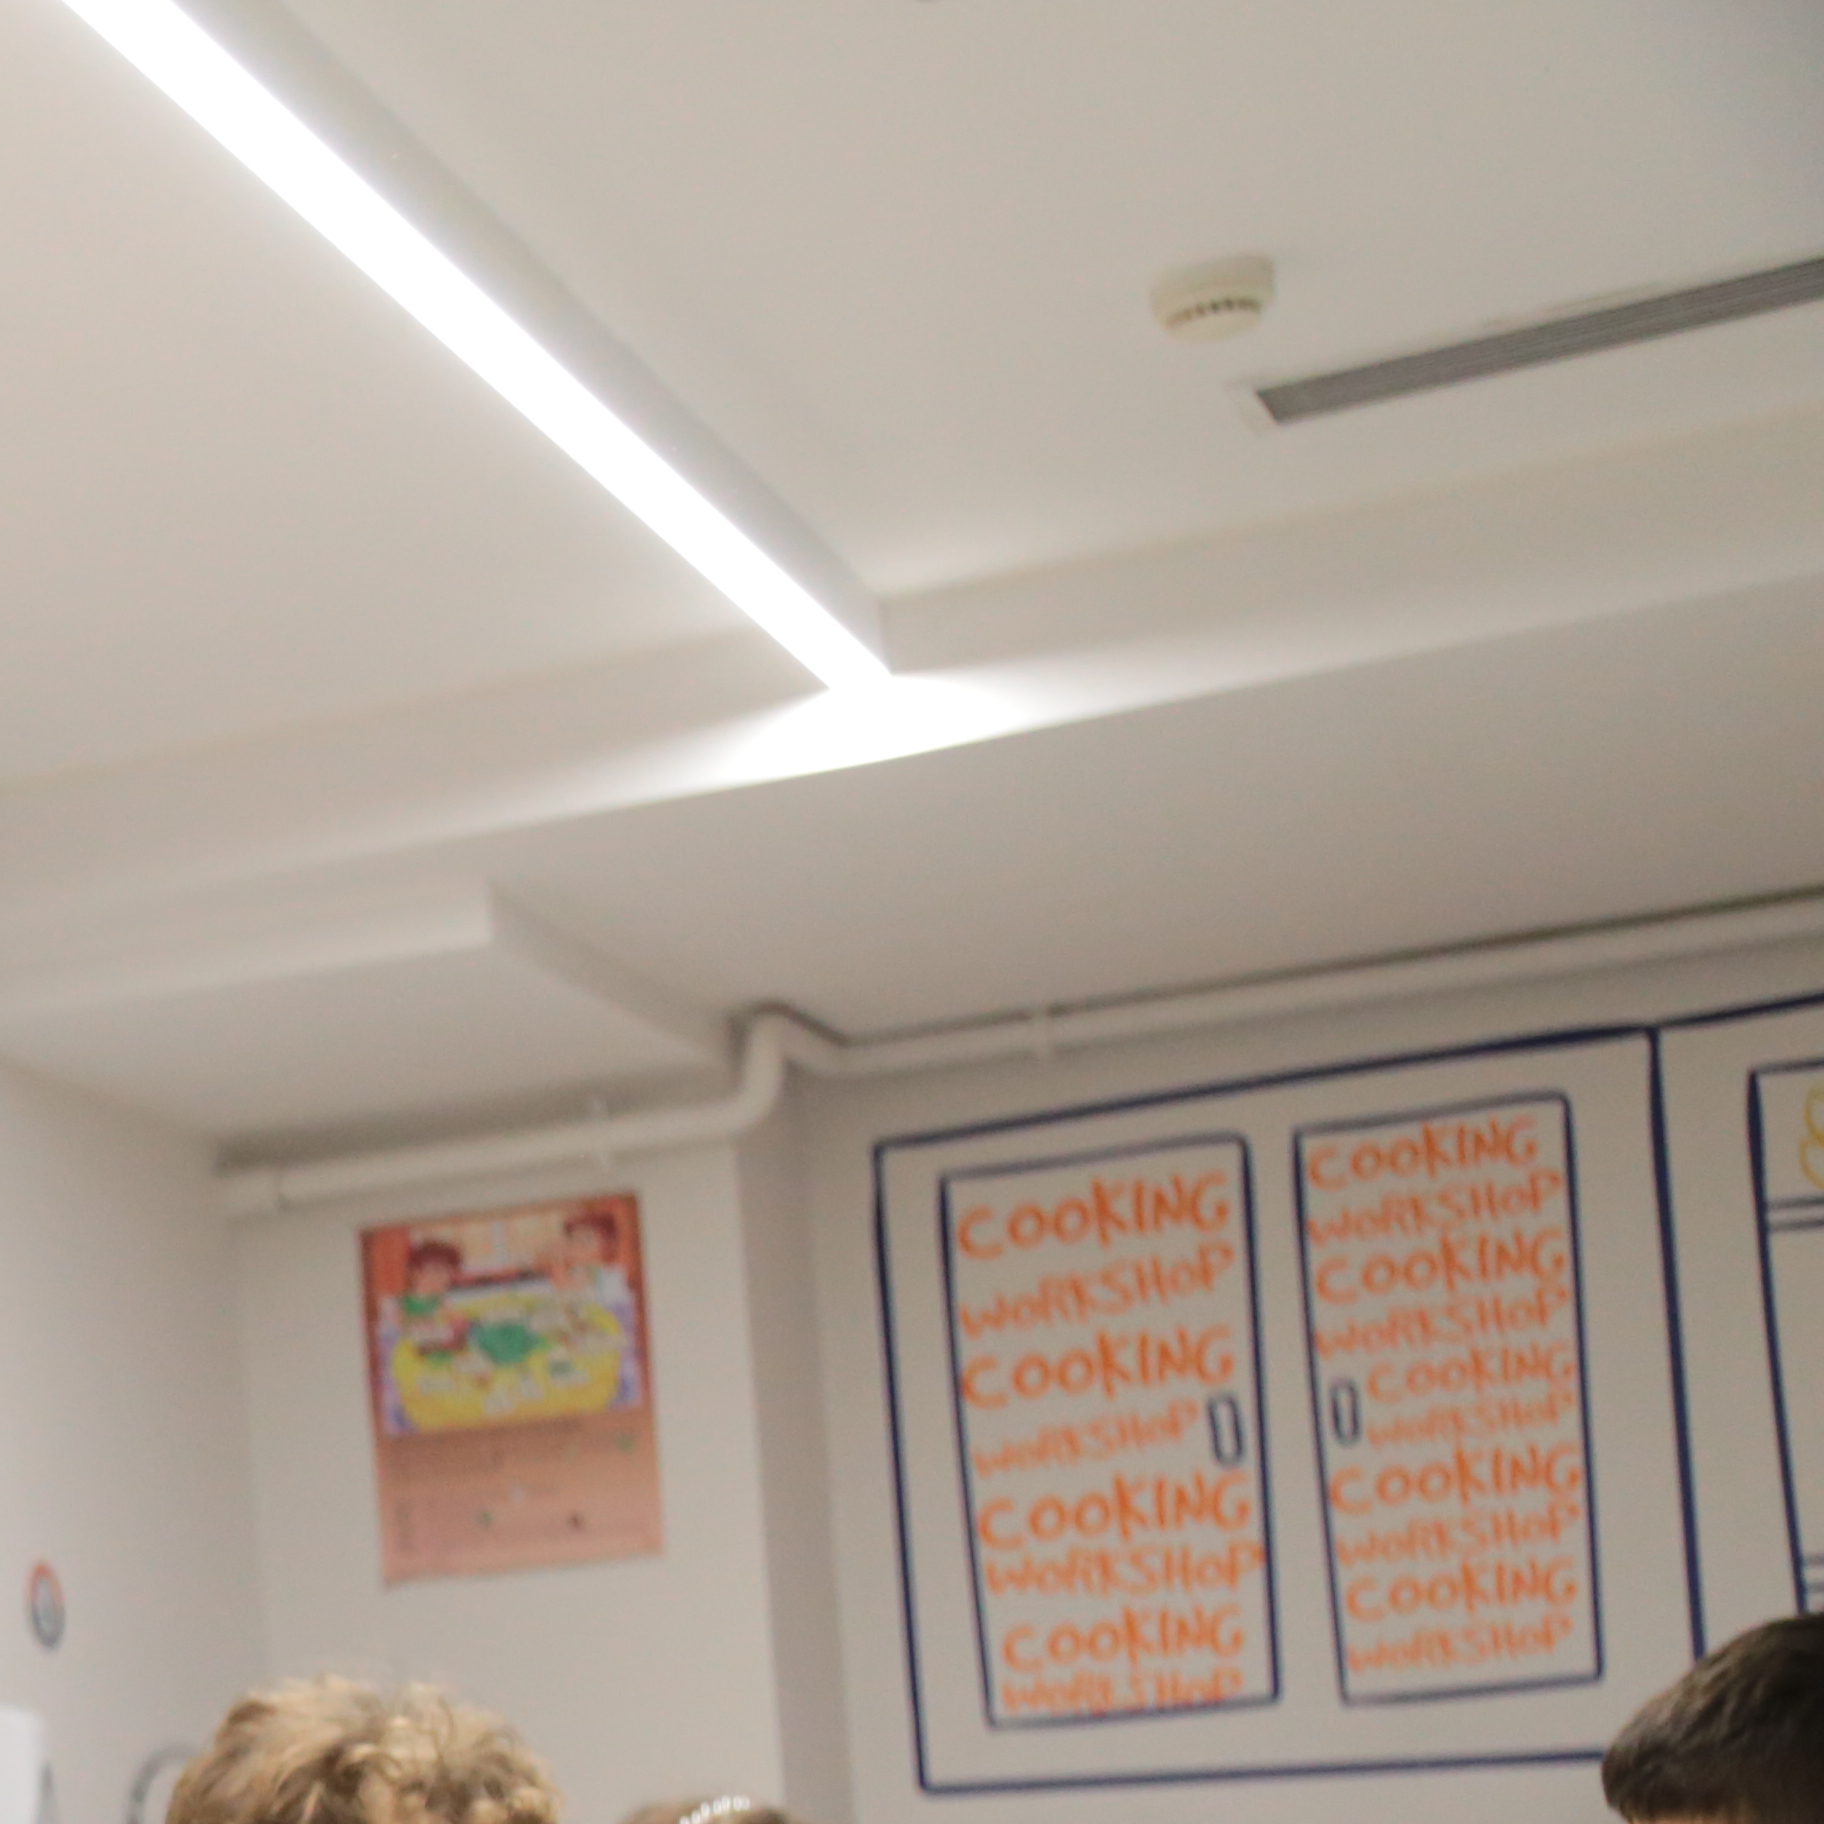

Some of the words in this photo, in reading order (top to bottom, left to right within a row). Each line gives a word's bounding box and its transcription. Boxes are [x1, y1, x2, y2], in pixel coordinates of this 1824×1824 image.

[1307, 1113, 1538, 1192] COOKING
[956, 1168, 1229, 1261] COOKING
[1314, 1226, 1566, 1305] COOKING
[961, 1322, 1235, 1410] COOKING
[1366, 1340, 1577, 1403] COOKING
[977, 1470, 1251, 1549] COOKING
[1329, 1440, 1583, 1516] COOKING
[1345, 1556, 1577, 1623] COOKING
[1002, 1603, 1244, 1673] COOKING
